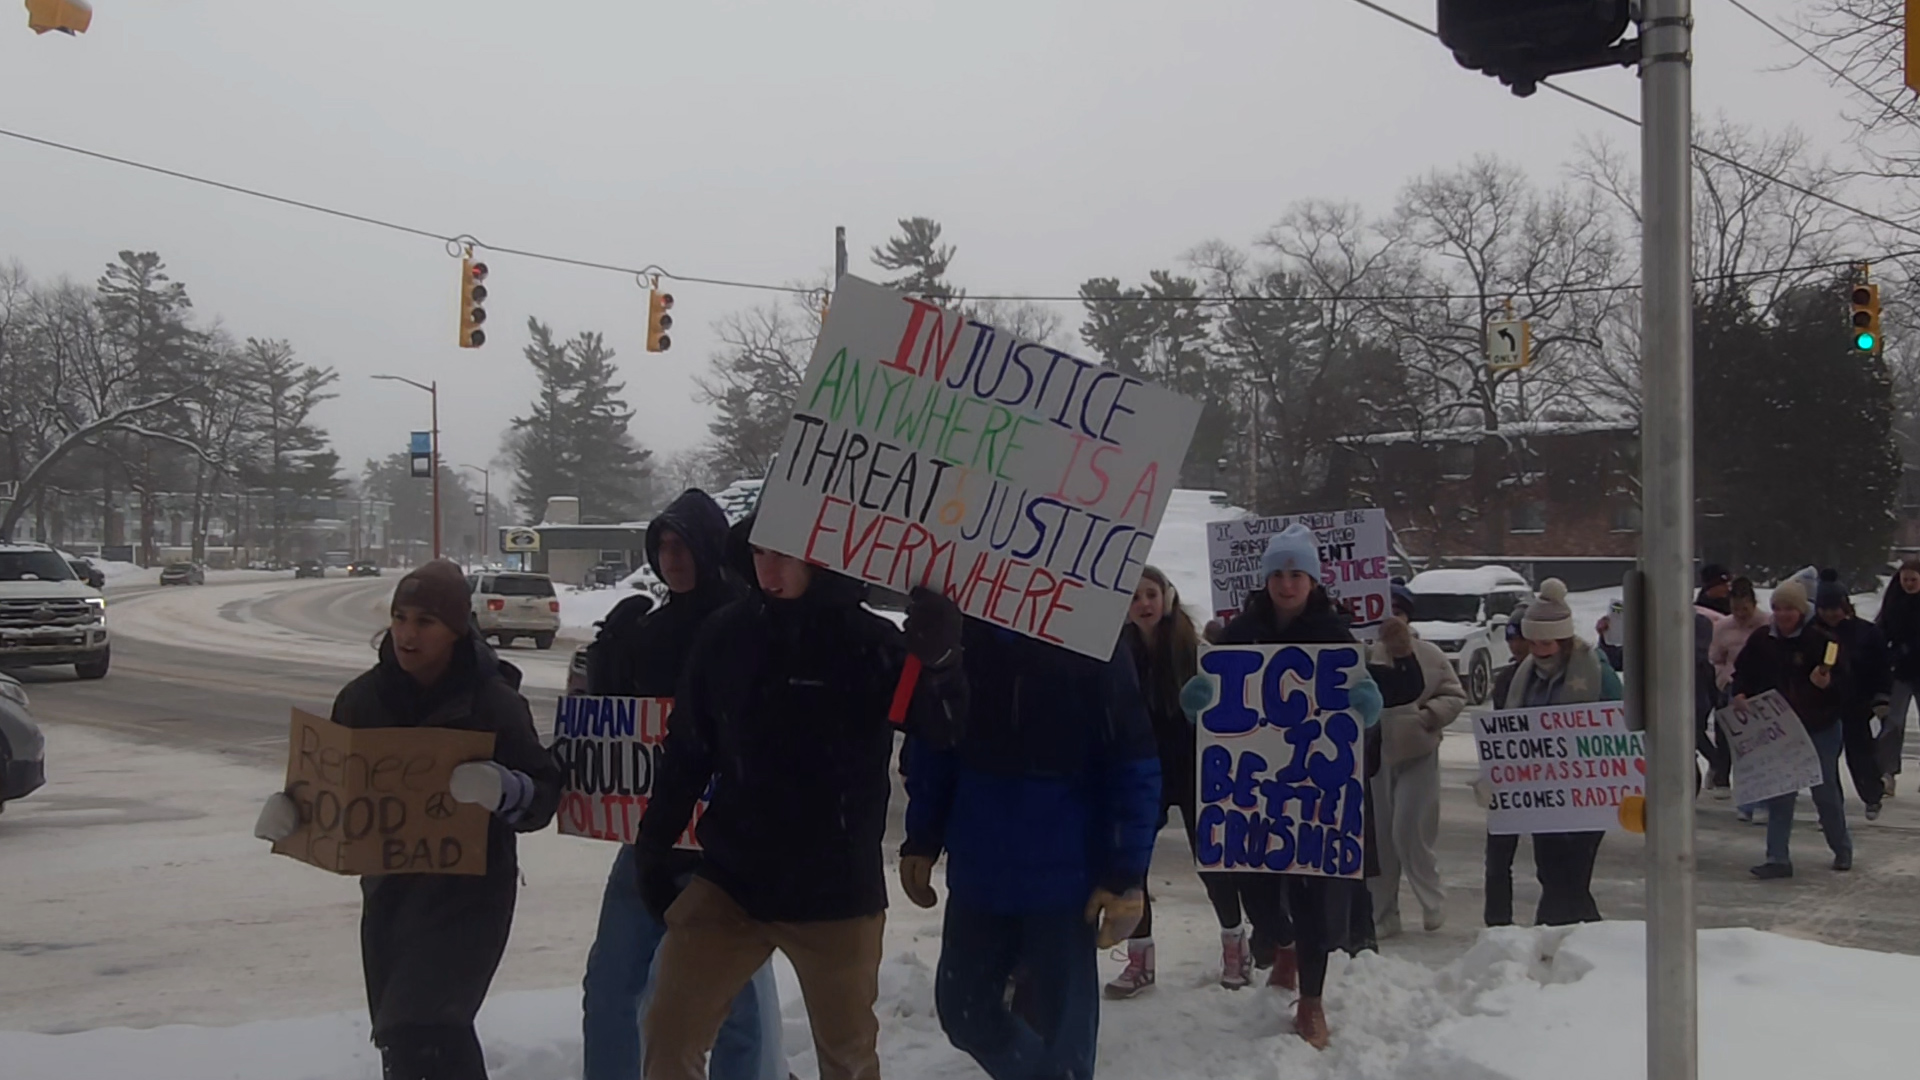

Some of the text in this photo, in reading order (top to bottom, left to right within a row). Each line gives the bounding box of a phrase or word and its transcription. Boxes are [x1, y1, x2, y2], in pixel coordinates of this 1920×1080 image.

[879, 297, 1143, 445] INJUSTICE
[1494, 354, 1518, 364] ONLY
[809, 347, 1159, 527] ANYWHERE IS A
[786, 414, 1154, 595] THREAT TO JUSTICE
[1215, 524, 1233, 541] I
[1299, 513, 1336, 529] NOT
[1344, 511, 1364, 525] BE
[1212, 543, 1355, 575] STAY ENT
[1315, 528, 1355, 543] WHO
[804, 495, 1084, 643] EVERYWHERE
[1213, 557, 1388, 591] WHIL STICE
[555, 696, 676, 744] HUMAN LI
[1480, 714, 1529, 735] WHEN
[300, 724, 436, 792] Renee
[1275, 712, 1358, 791] IS
[1480, 734, 1645, 761] BECOMES NORMA
[1490, 758, 1627, 784] COMPASSION
[284, 780, 406, 841] GOOD
[1200, 744, 1363, 837] BETTER
[306, 832, 463, 871] ICE BAD
[1196, 804, 1362, 875] CRUSHED
